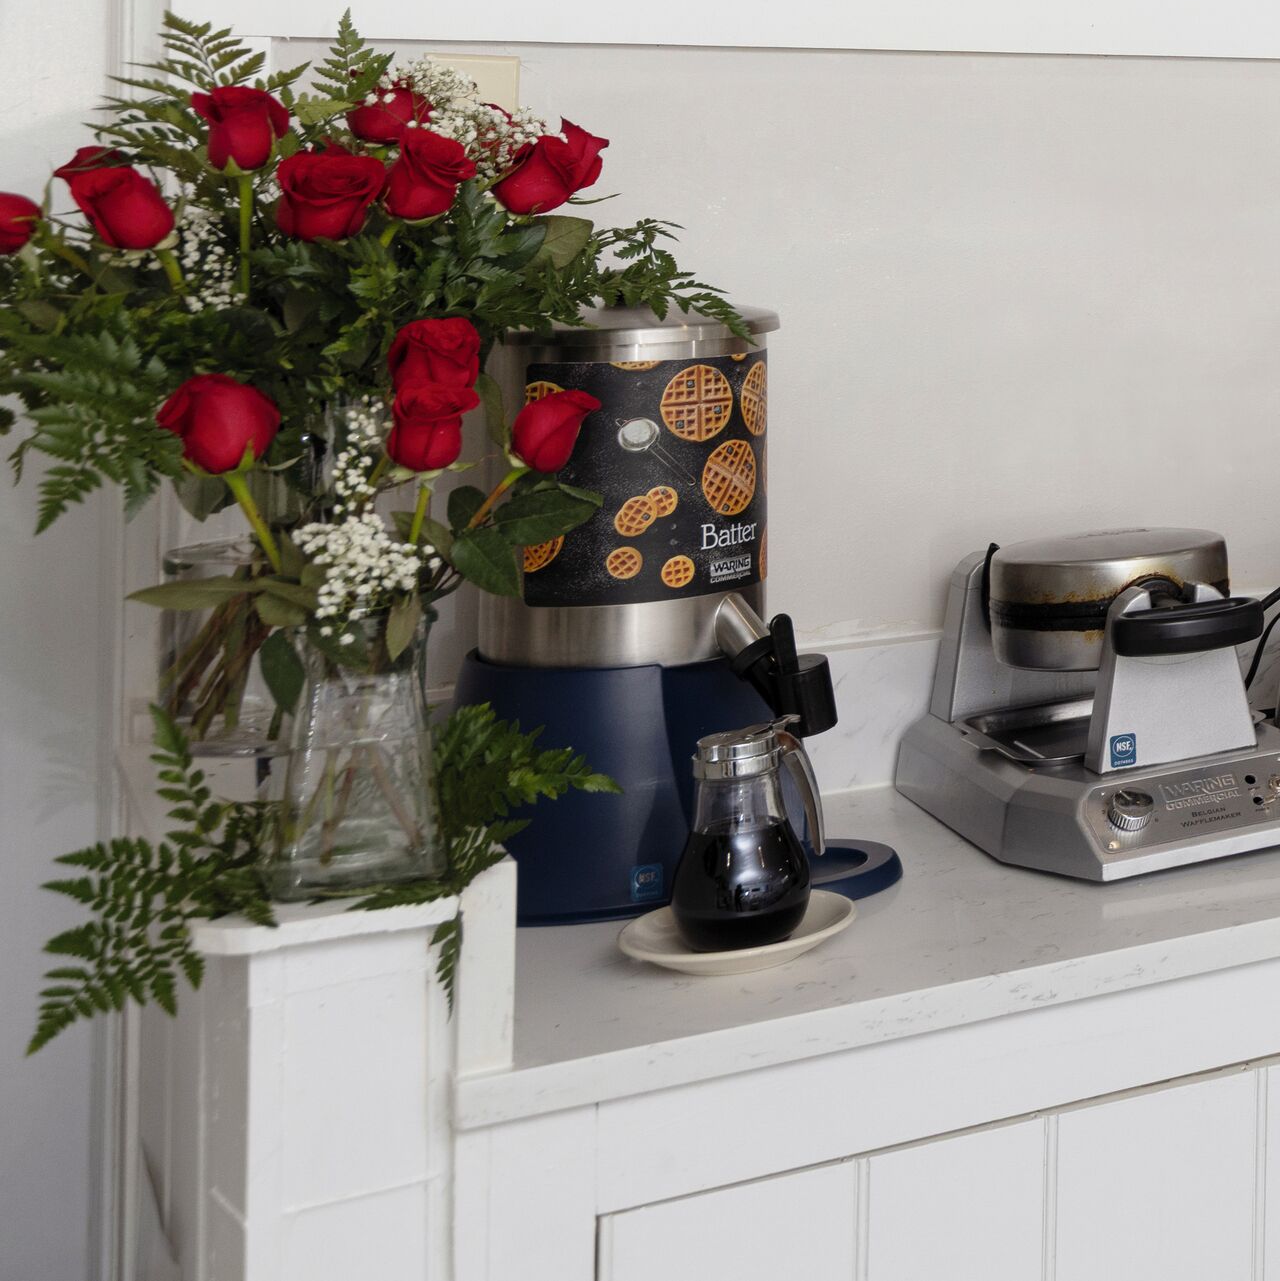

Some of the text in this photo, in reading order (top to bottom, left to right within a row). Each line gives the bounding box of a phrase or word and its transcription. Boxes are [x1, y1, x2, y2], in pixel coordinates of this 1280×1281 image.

[700, 522, 758, 551] Batter
[713, 557, 750, 574] WARING
[1116, 740, 1132, 753] NSF
[1165, 774, 1236, 797] WARING
[1166, 789, 1241, 811] COMMERCIAL
[1181, 812, 1242, 828] WAFFLEMAKER
[1191, 807, 1227, 818] BELGIAN
